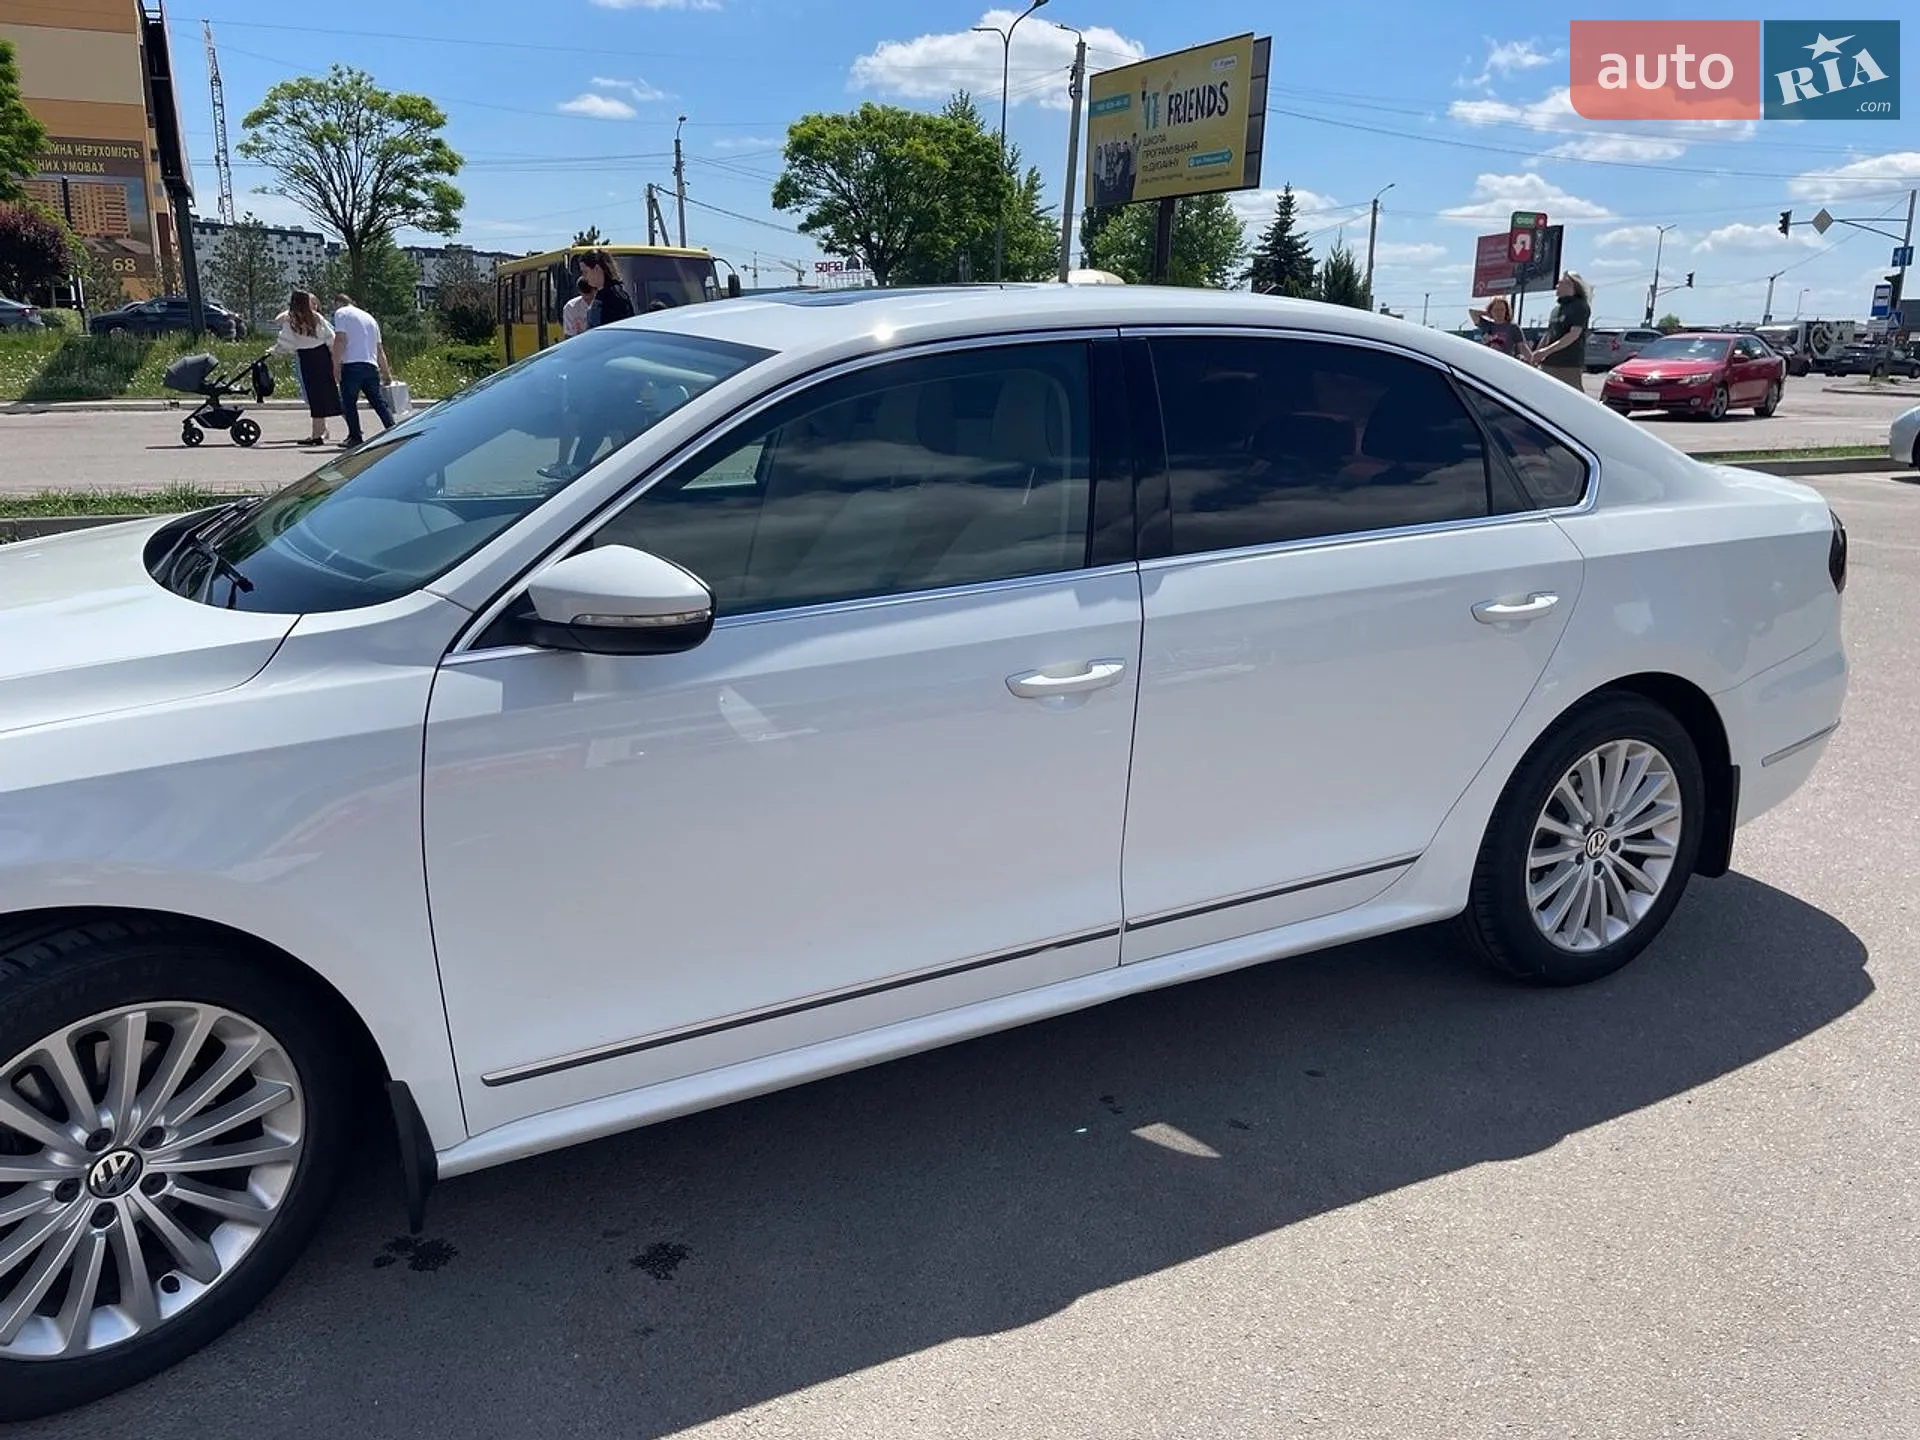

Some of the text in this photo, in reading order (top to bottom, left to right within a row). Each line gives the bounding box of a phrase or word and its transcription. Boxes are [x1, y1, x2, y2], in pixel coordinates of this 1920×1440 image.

[1167, 80, 1230, 127] FRIENDS
[75, 143, 139, 159] НЕРУХОМІСТЬ
[62, 160, 105, 173] УМОВАХ
[112, 257, 136, 272] 68
